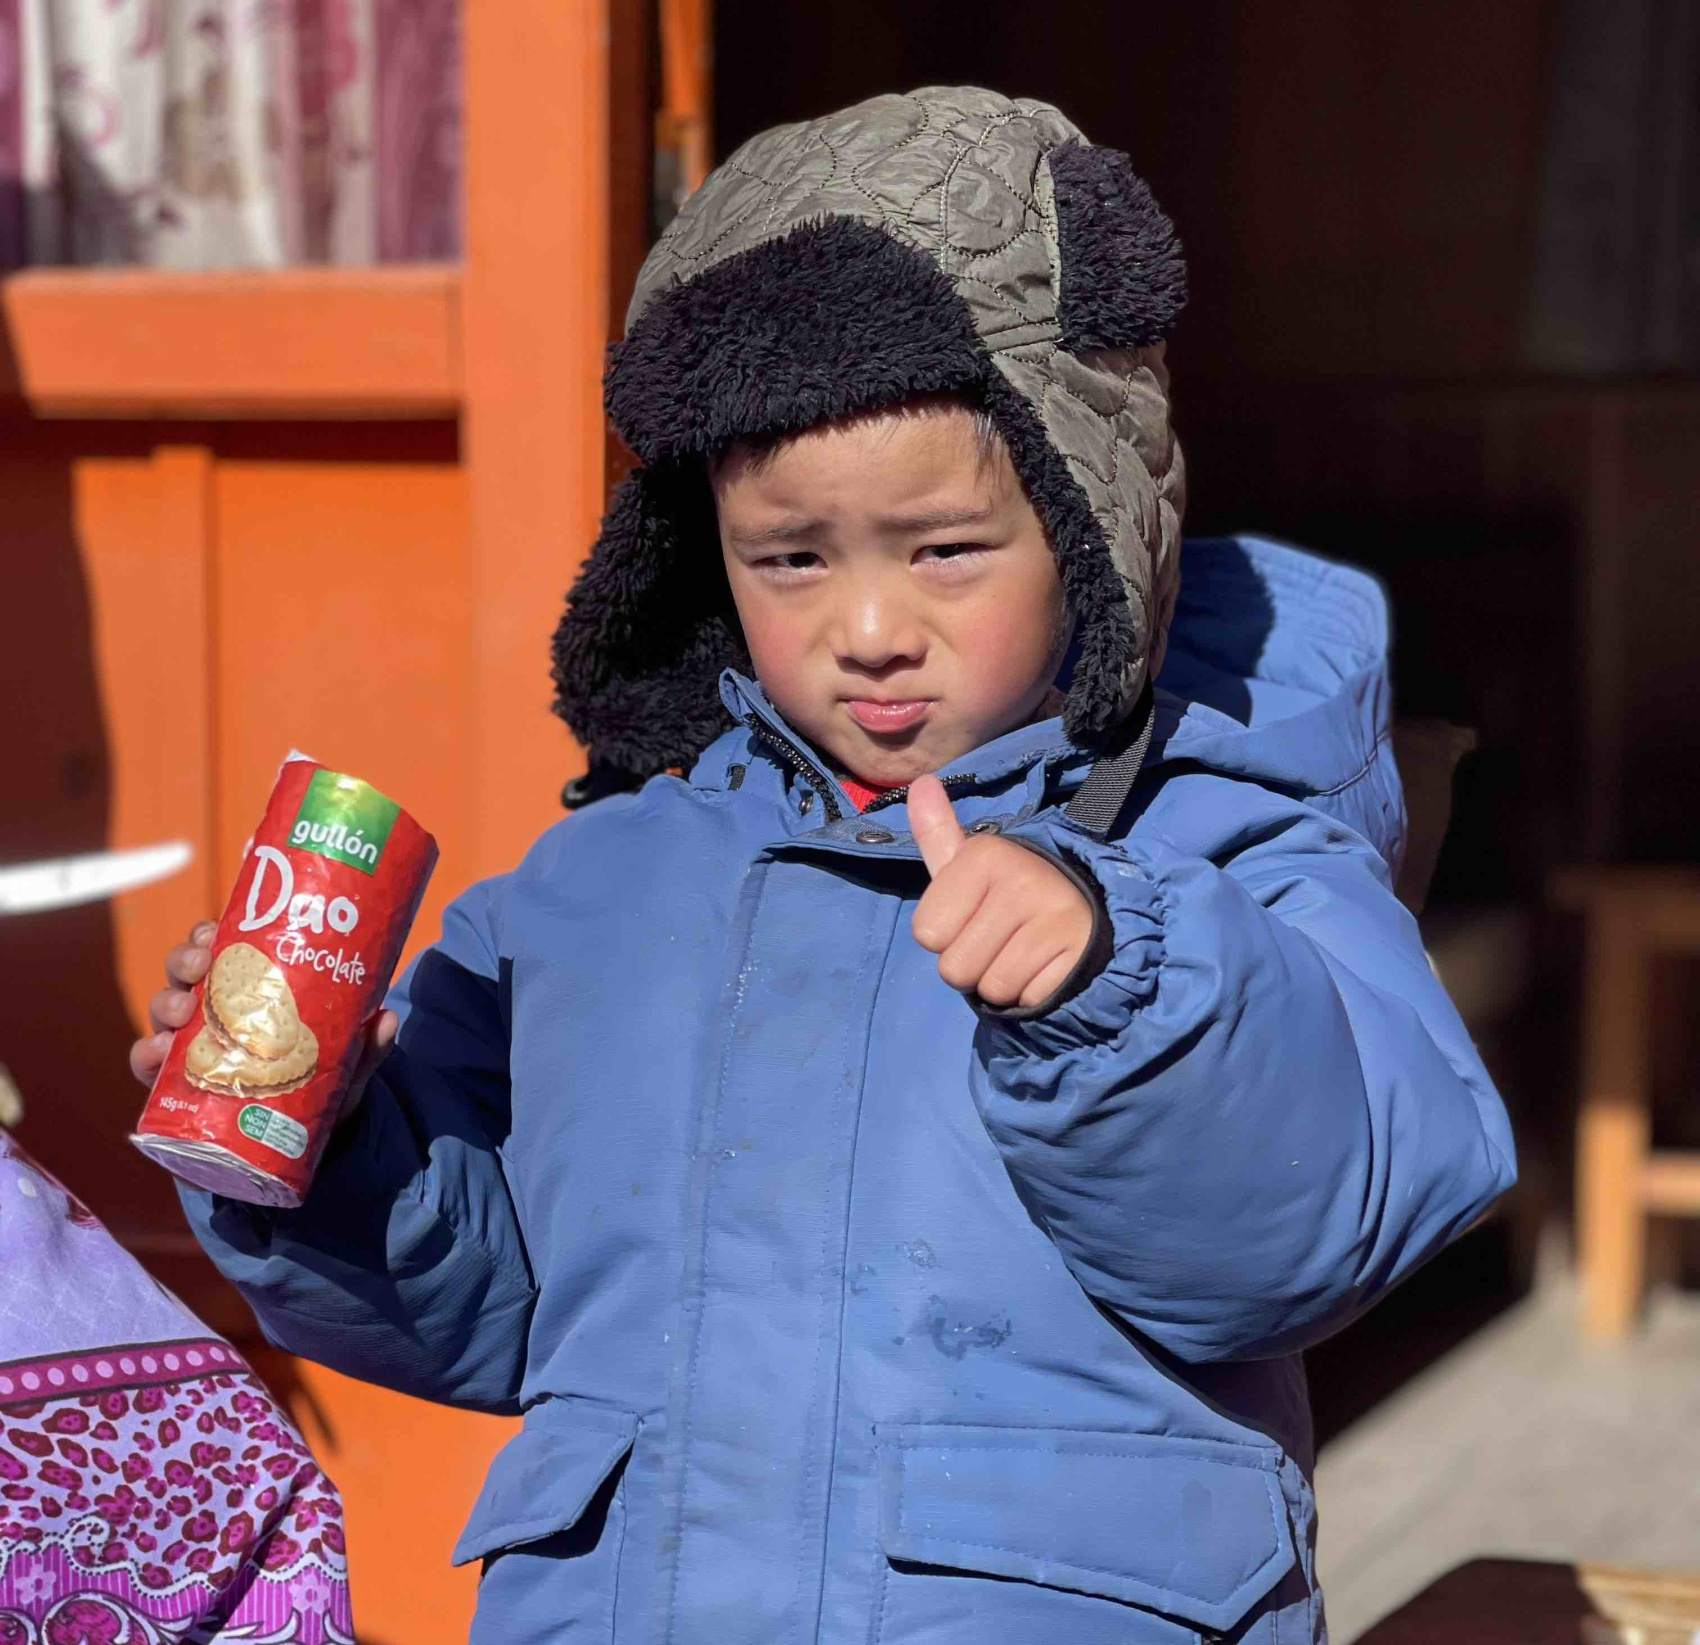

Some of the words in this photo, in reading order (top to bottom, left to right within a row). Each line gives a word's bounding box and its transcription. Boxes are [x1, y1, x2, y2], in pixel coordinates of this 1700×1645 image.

[291, 820, 378, 864] gullón
[275, 932, 366, 985] Chocolate
[244, 1113, 266, 1130] NON
